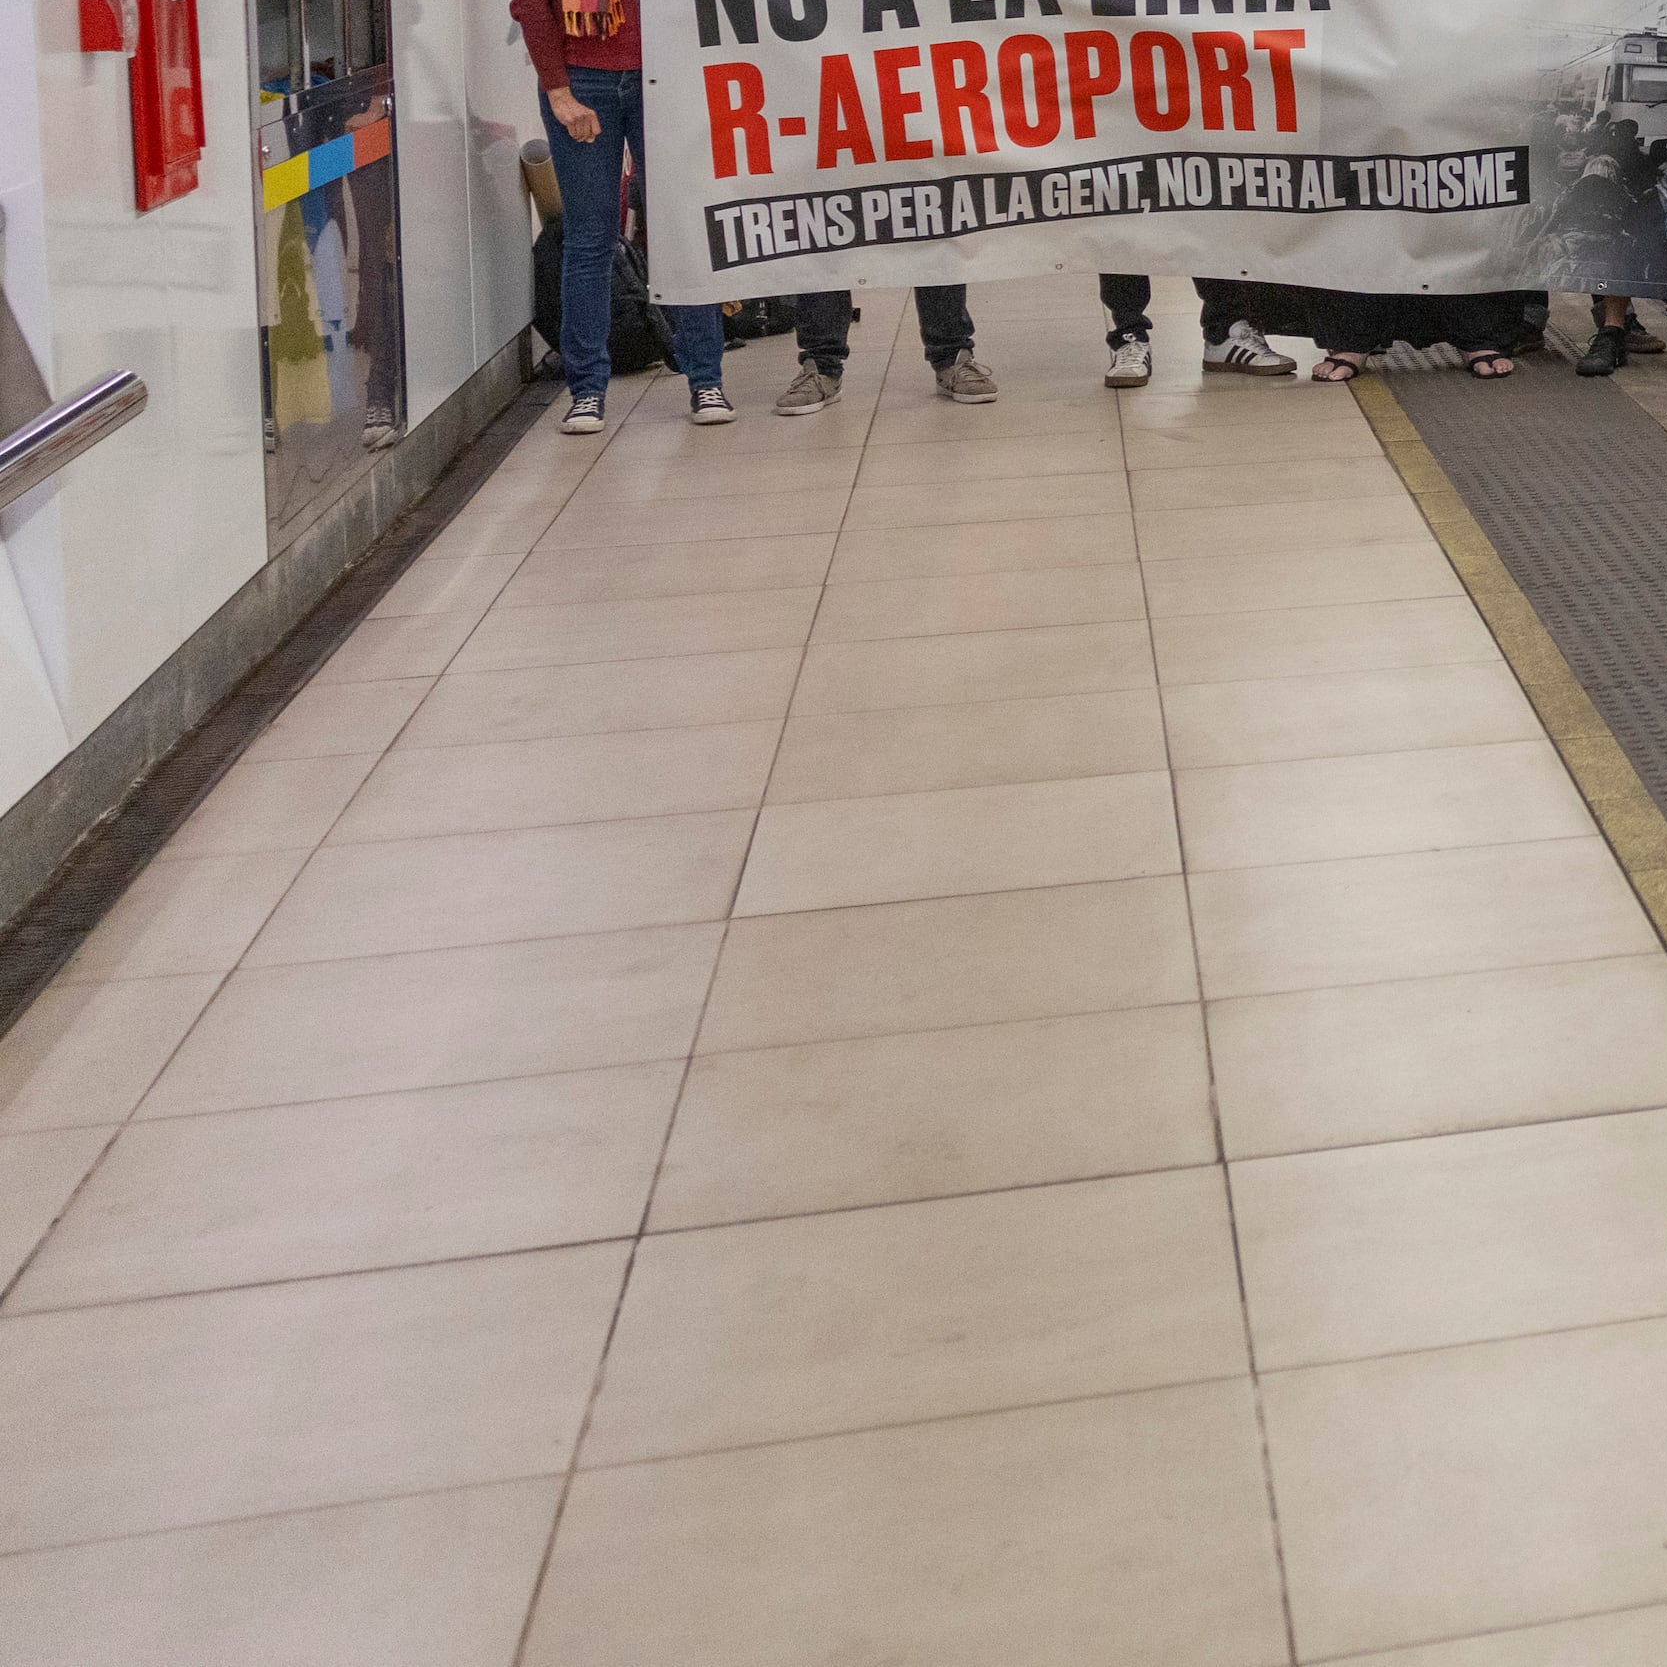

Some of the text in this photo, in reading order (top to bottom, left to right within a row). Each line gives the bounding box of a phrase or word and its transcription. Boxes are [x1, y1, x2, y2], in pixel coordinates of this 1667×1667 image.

[701, 29, 1306, 180] R-AEROPORT
[714, 150, 1519, 264] TRENS PER A LA GENT, NO PER AL TURISME
